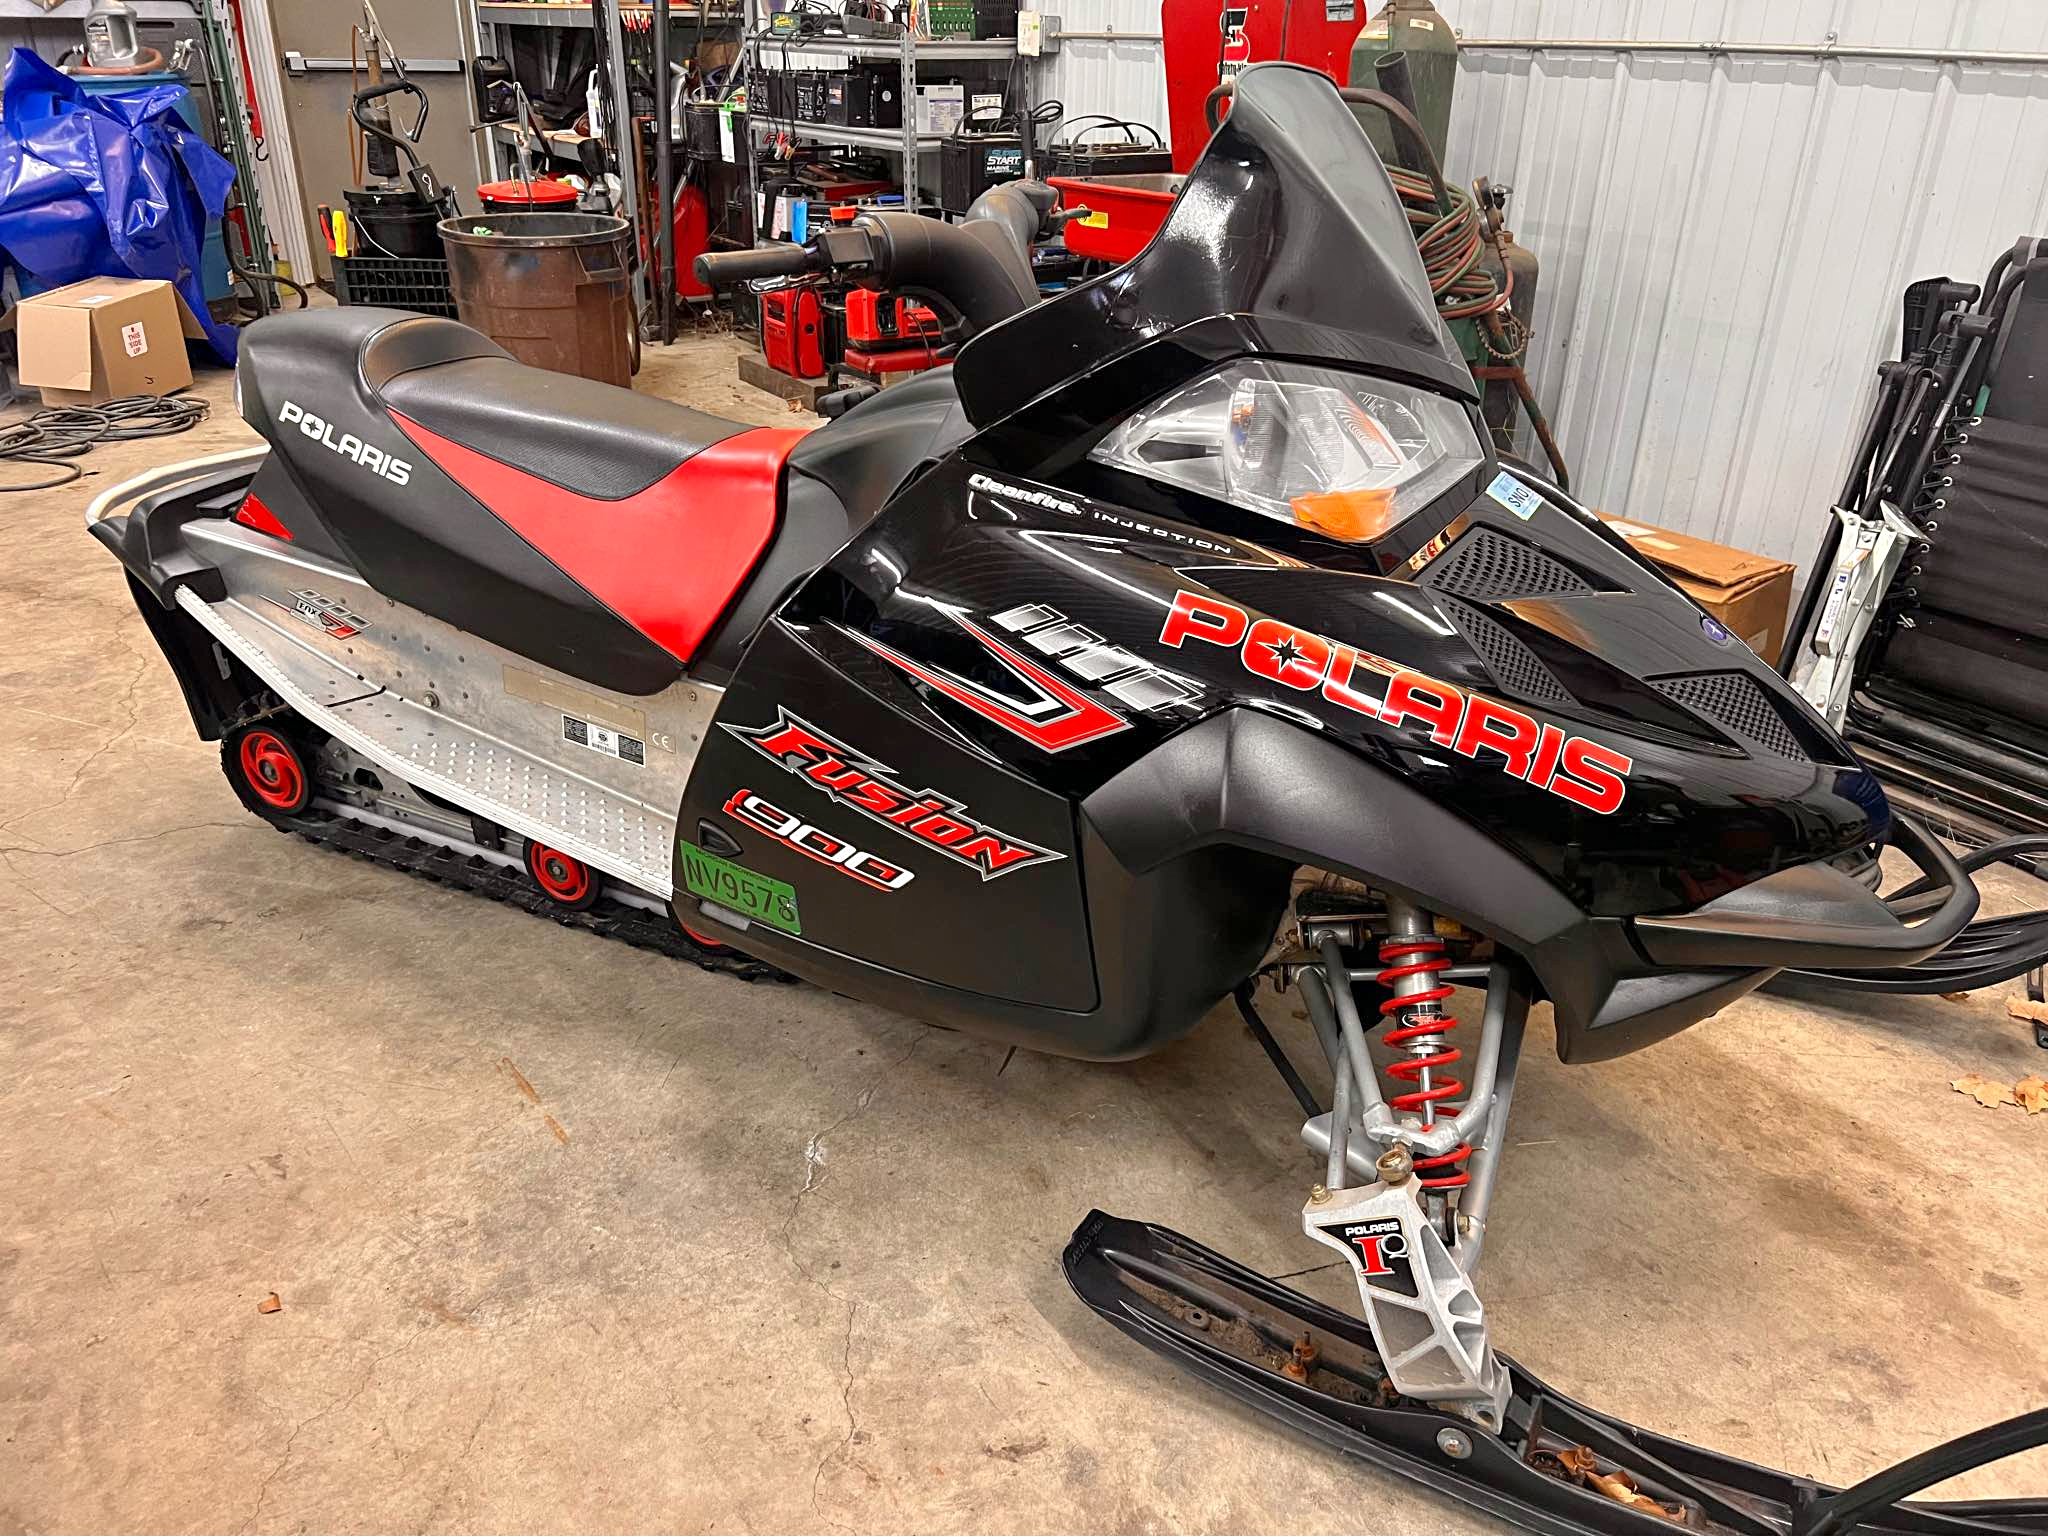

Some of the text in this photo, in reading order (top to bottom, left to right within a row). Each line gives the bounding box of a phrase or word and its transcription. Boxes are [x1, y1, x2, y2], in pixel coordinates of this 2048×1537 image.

[986, 156, 1021, 165] START
[128, 332, 140, 341] THIS
[129, 339, 142, 349] SIDE
[278, 400, 412, 486] POLARIS
[1507, 487, 1529, 508] SNO
[1094, 510, 1231, 555] INJECTION
[299, 602, 317, 615] FOX
[1158, 588, 1633, 815] POLARIS
[652, 732, 669, 749] CE
[729, 792, 915, 890] 900
[685, 854, 796, 922] NV9578
[1345, 1221, 1399, 1236] POLARIS
